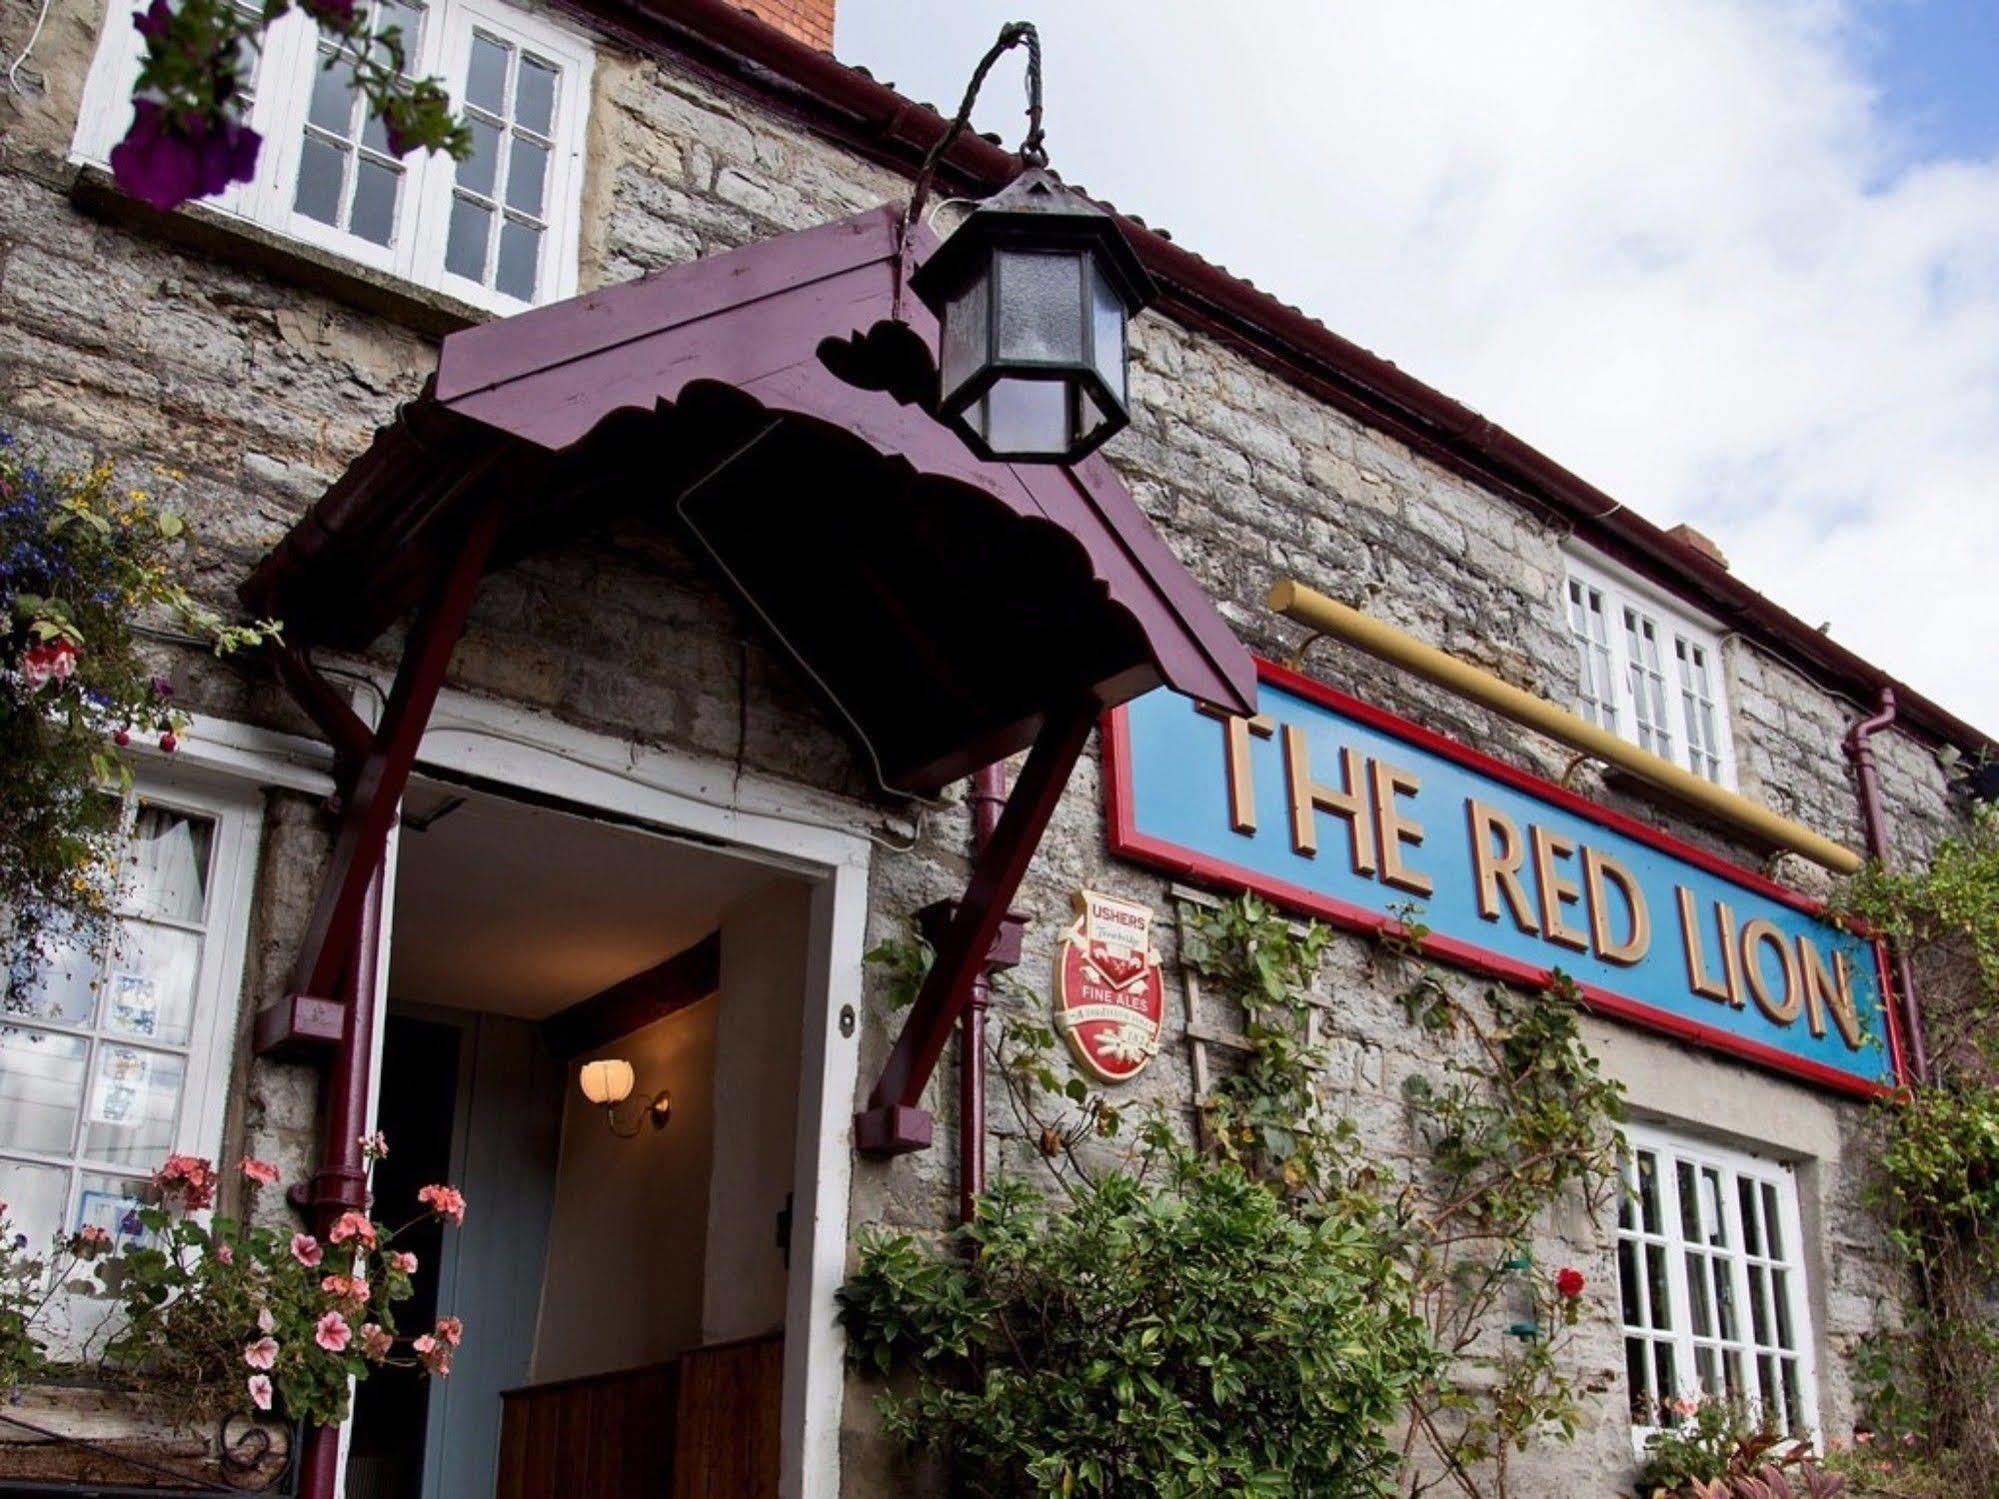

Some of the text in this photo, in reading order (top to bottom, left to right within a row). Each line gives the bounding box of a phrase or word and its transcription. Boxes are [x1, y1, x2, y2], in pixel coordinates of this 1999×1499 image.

[1195, 702, 1862, 1051] THE RED LION
[1092, 903, 1145, 931] USHERS
[1082, 985, 1149, 1012] FINE ALES
